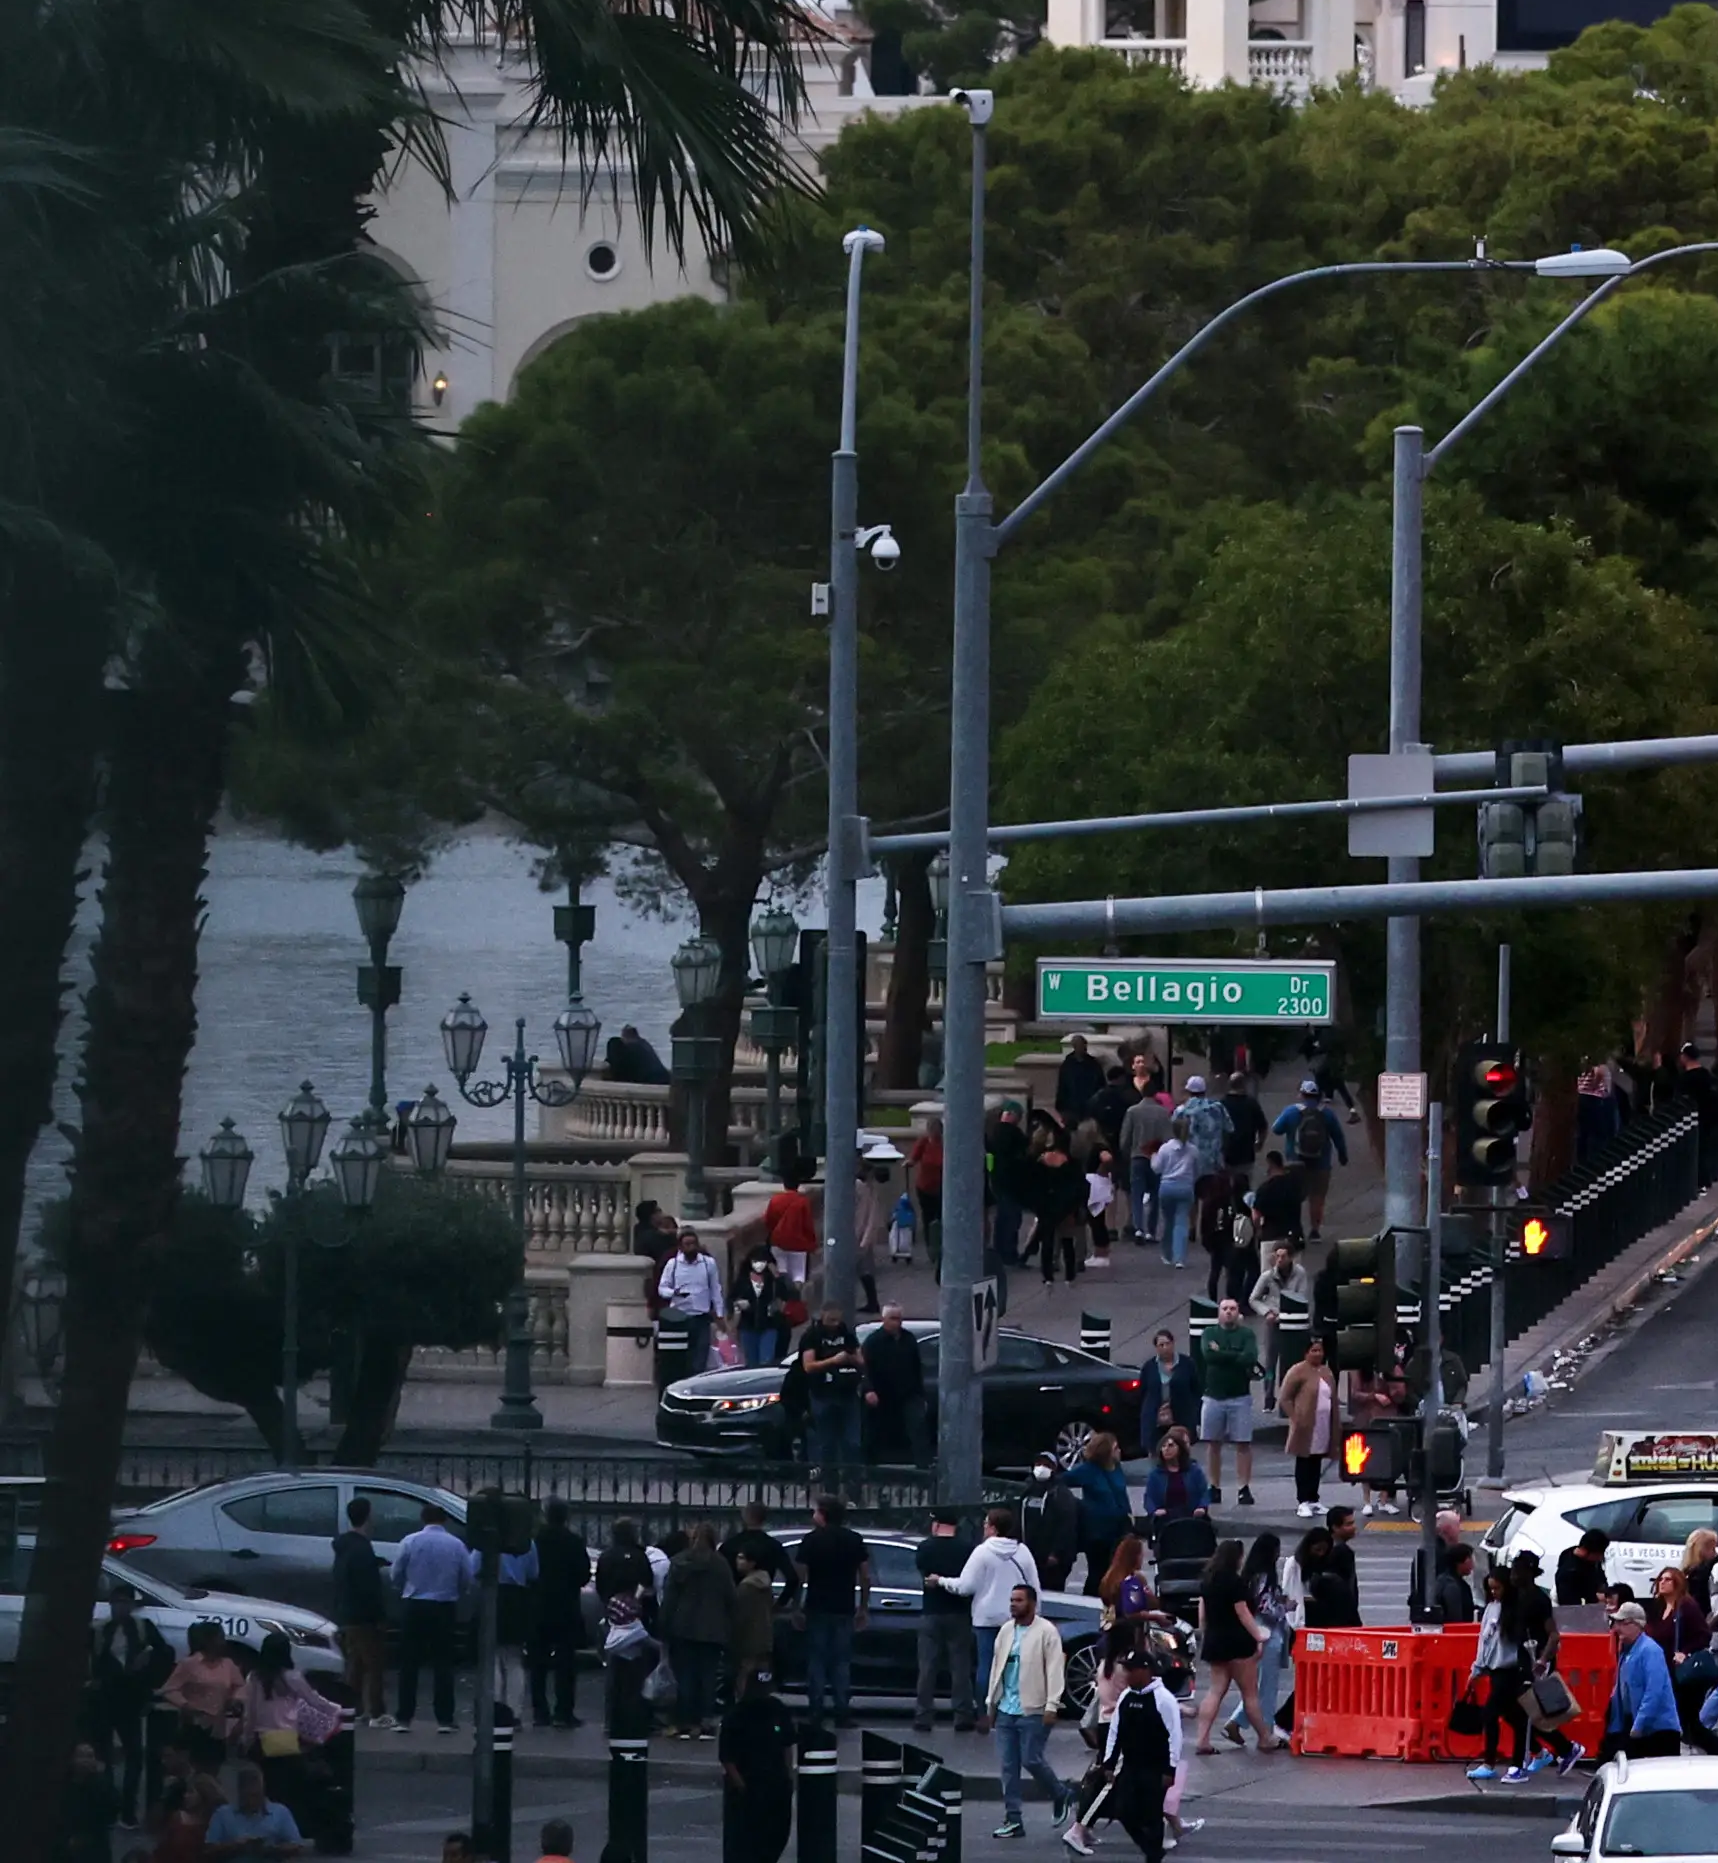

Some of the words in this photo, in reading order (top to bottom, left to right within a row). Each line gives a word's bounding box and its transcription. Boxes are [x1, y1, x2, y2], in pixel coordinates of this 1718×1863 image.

[1048, 973, 1061, 991] W
[1086, 973, 1243, 1011] Bellagio
[1290, 976, 1309, 993] Dr
[1278, 997, 1323, 1016] 2300
[1638, 1548, 1666, 1558] VEGAS
